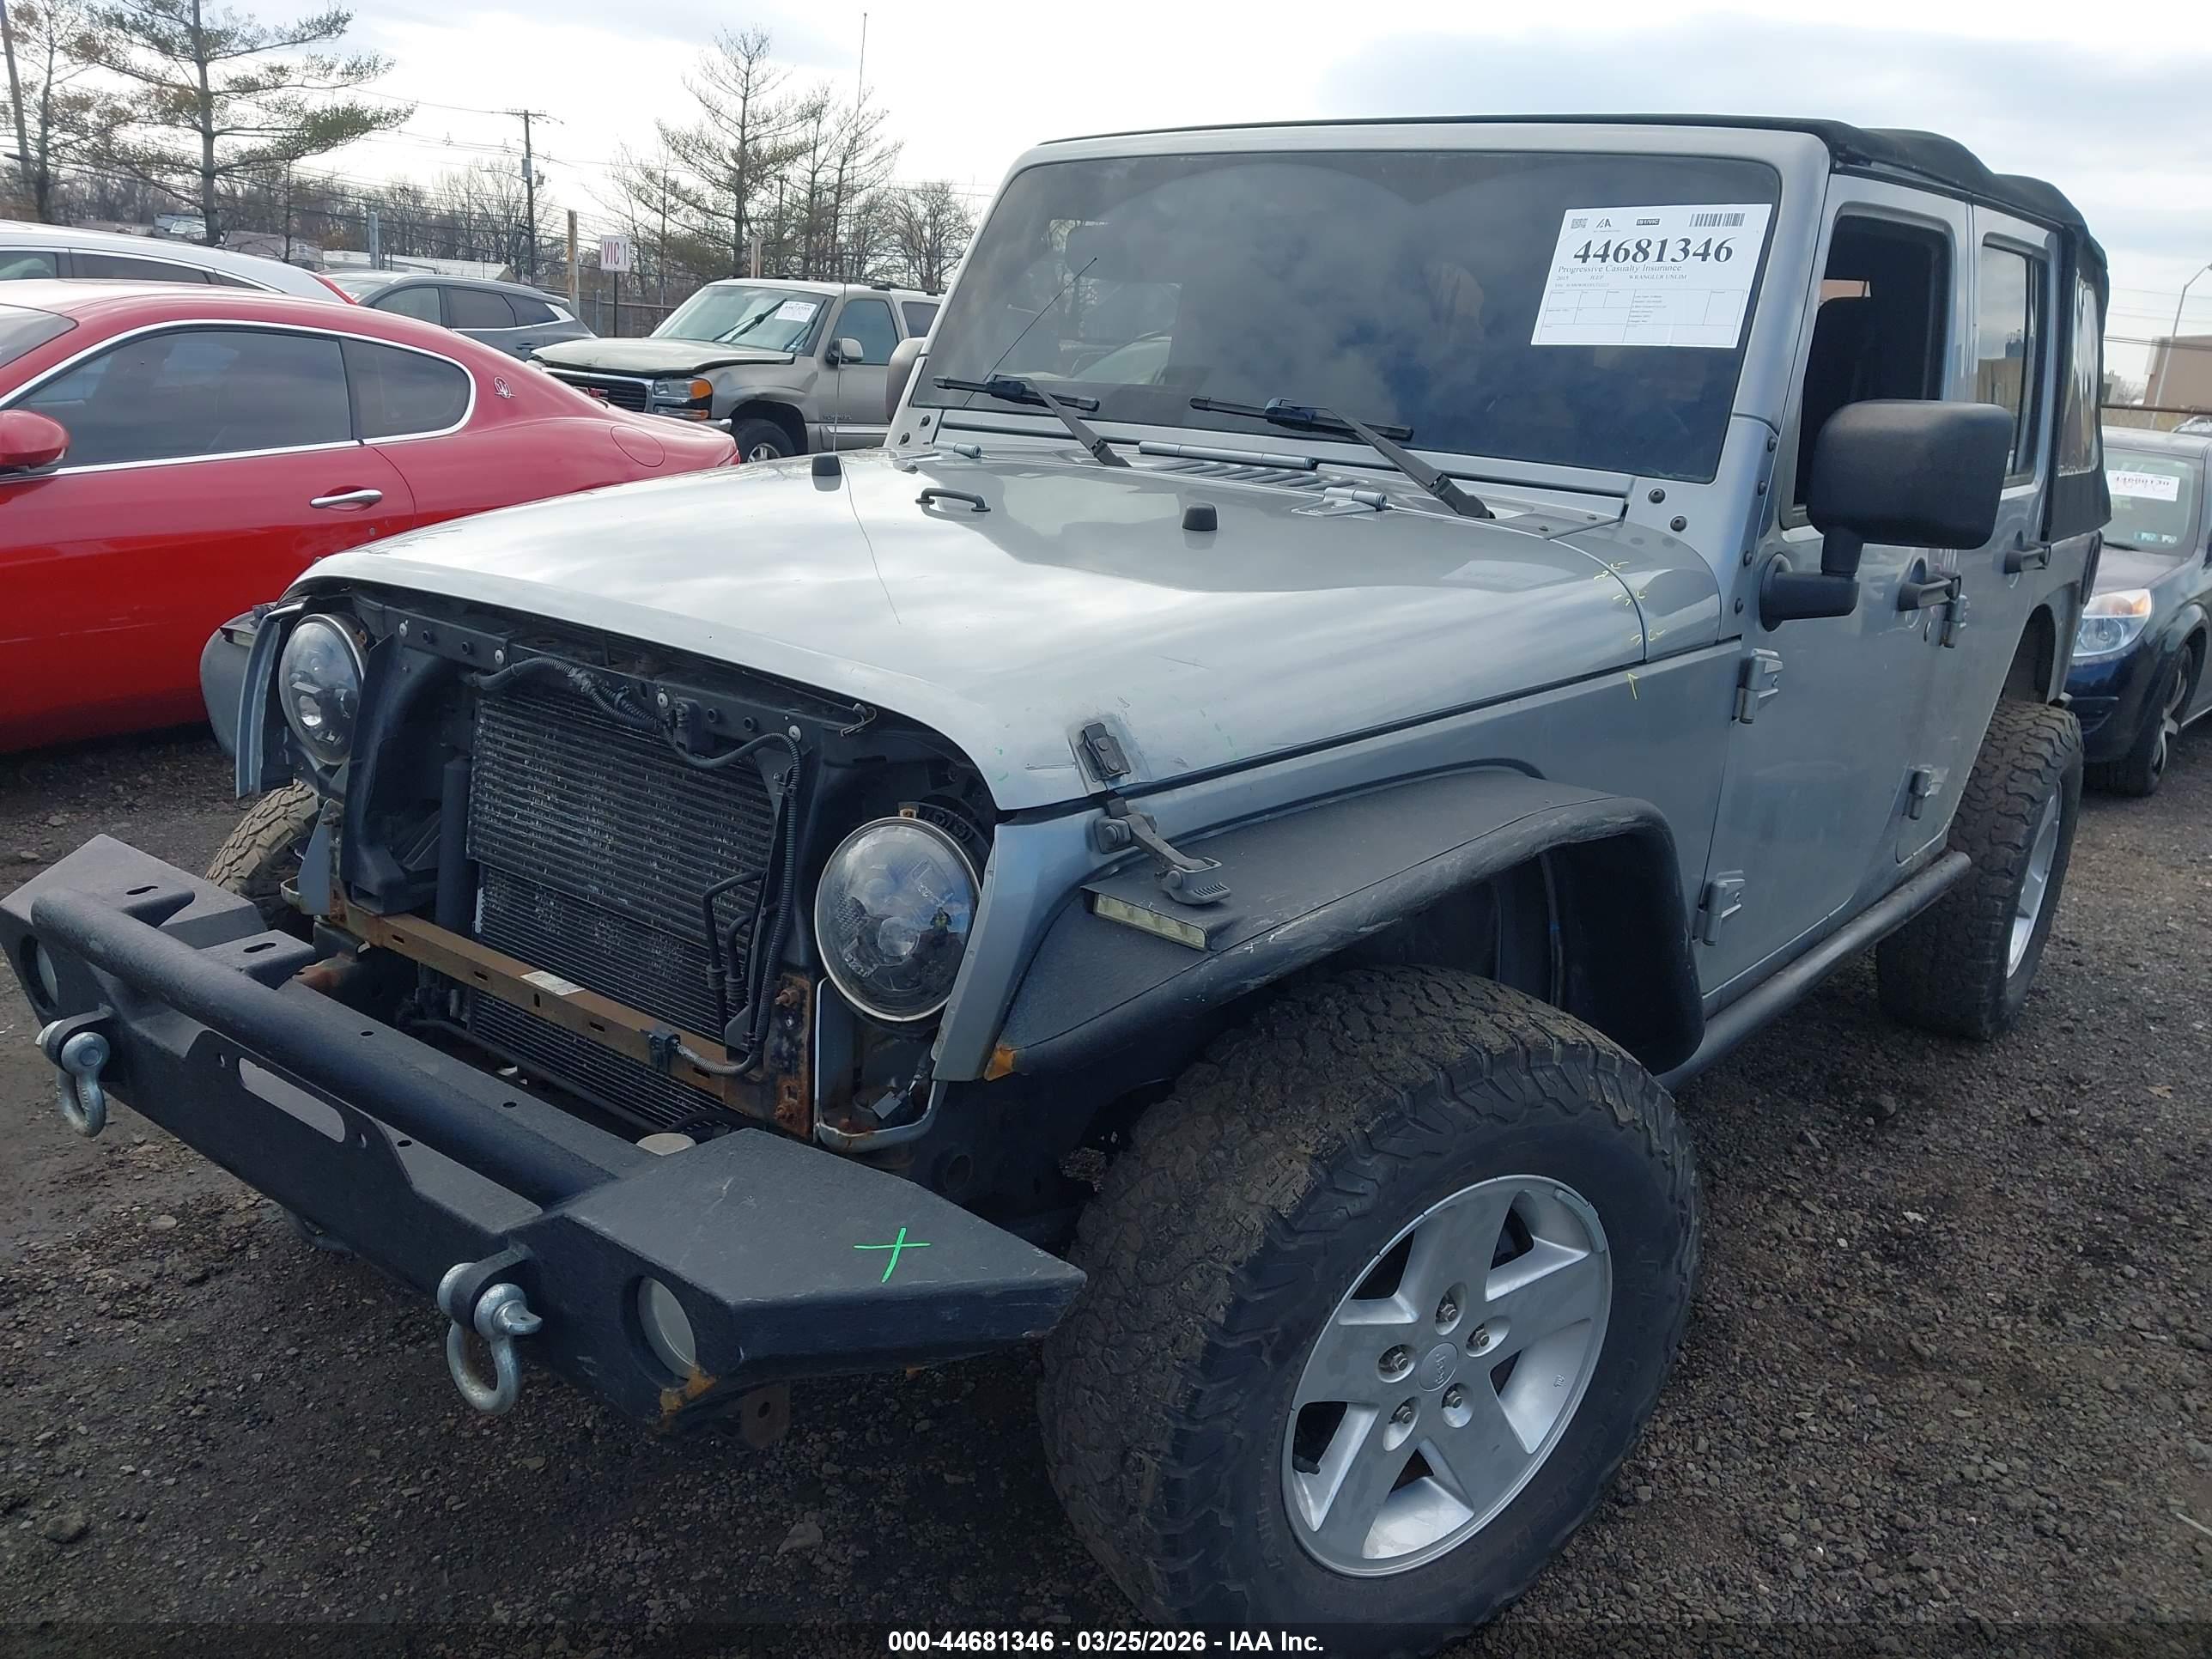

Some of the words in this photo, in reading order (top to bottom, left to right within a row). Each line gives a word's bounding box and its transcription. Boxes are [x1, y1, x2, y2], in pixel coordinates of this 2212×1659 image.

[604, 241, 620, 265] VIC
[623, 243, 627, 265] 1
[1573, 236, 1737, 264] 44681346
[1558, 265, 1603, 274] Progressive
[1605, 264, 1639, 273] Casualty
